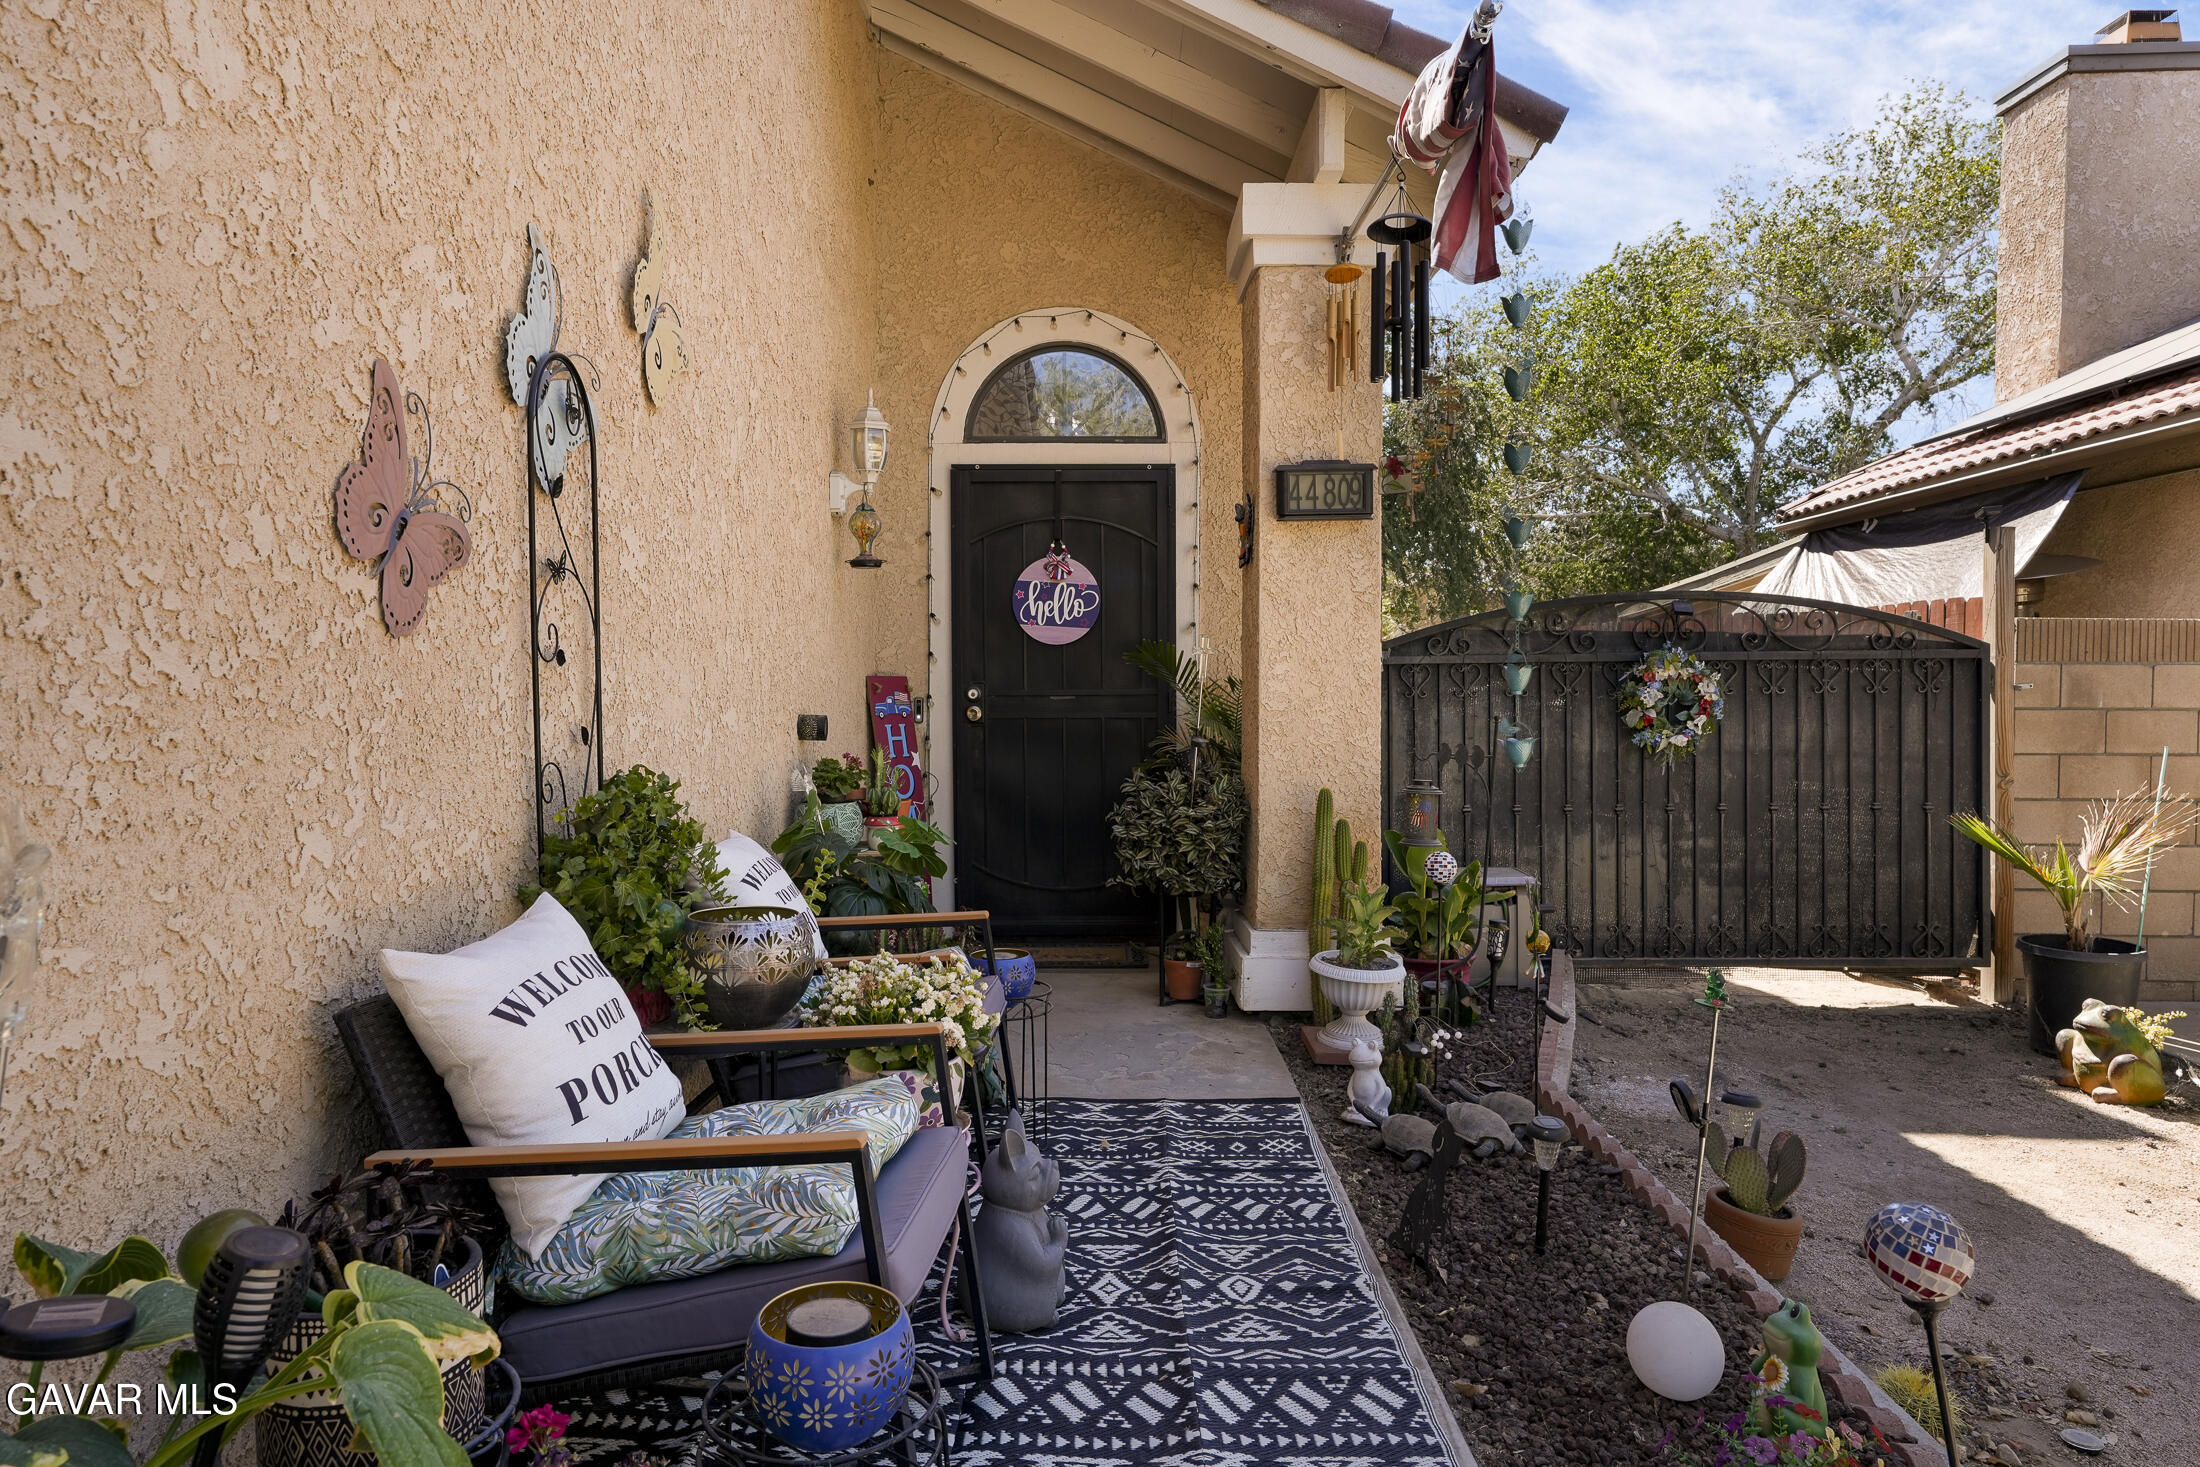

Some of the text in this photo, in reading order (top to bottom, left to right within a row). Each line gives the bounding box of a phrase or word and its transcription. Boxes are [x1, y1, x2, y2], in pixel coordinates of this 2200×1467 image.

[1288, 472, 1361, 510] 44809
[1020, 580, 1099, 626] hello
[775, 888, 792, 905] TO
[565, 997, 626, 1045] TO OUR
[555, 1030, 662, 1127] PORCH
[633, 1110, 651, 1141] and
[651, 1106, 669, 1136] stay
